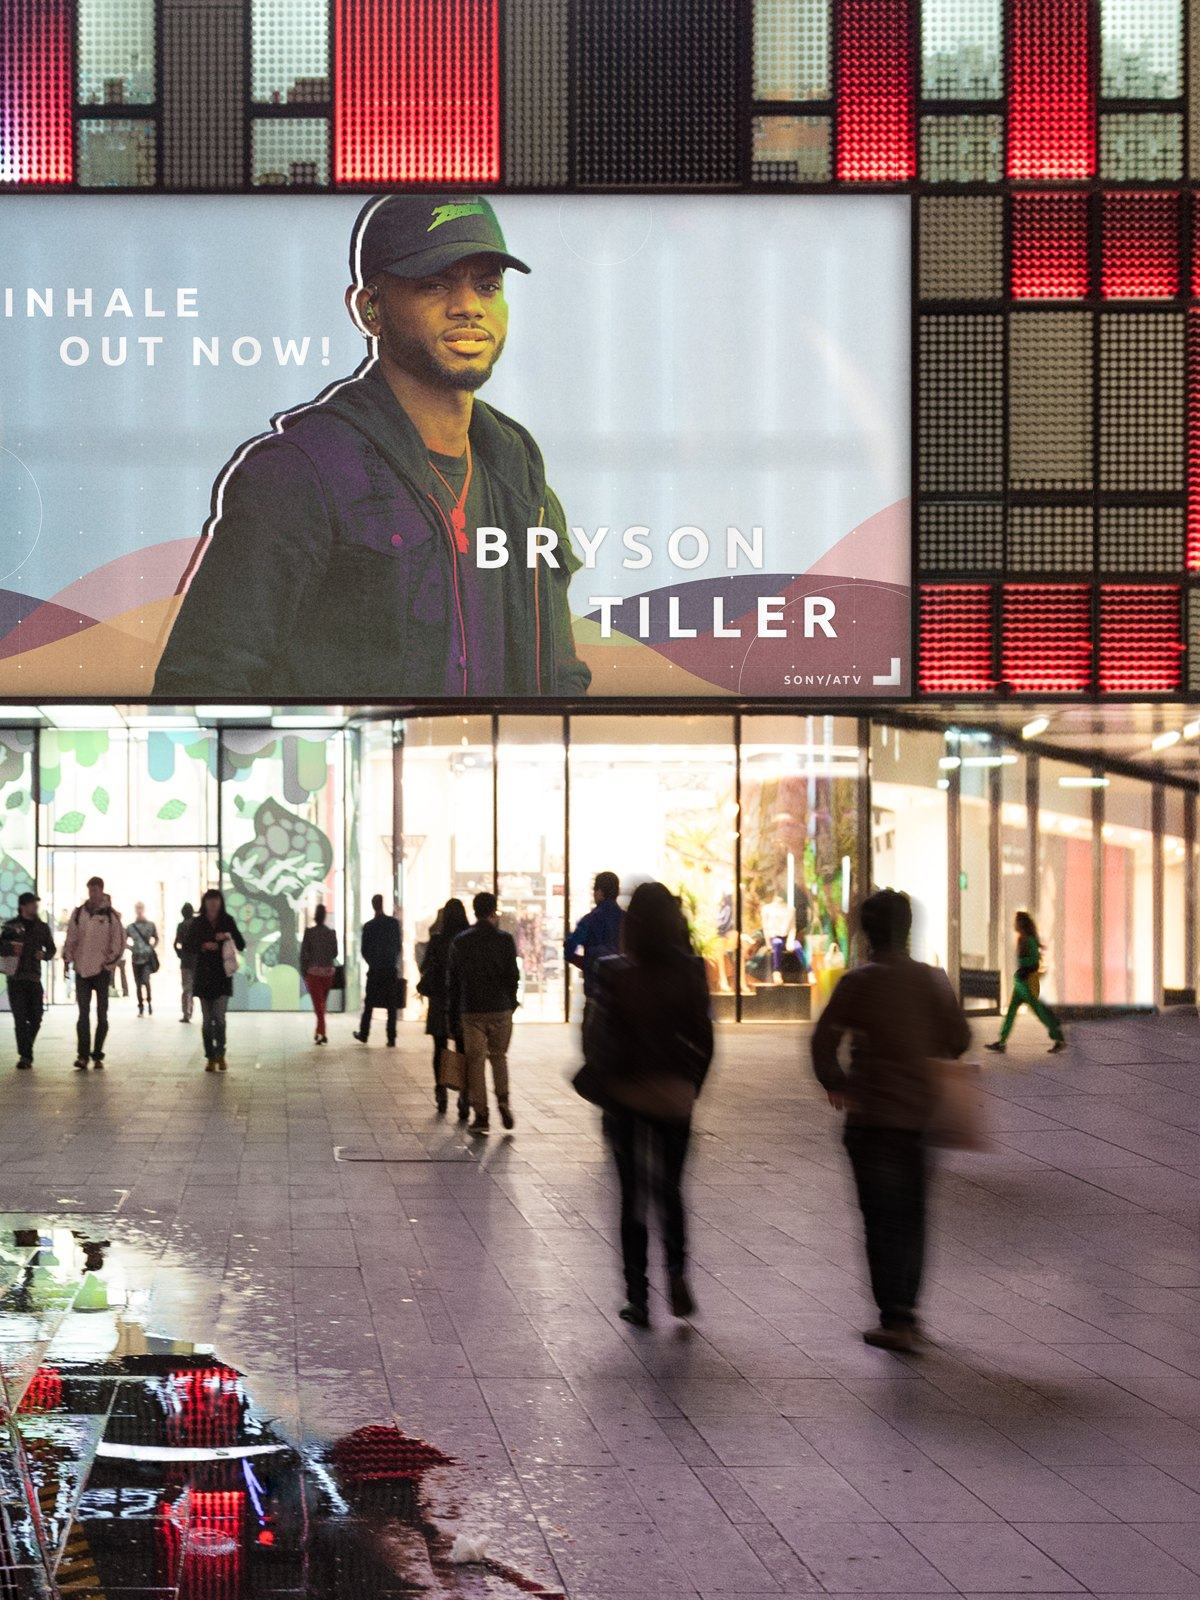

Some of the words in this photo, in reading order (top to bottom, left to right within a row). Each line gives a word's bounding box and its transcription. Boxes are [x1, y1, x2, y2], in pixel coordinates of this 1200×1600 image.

[5, 288, 199, 317] INHALE
[59, 336, 163, 366] OUT
[193, 336, 331, 366] NOW!
[475, 526, 765, 569] BRYSON
[589, 596, 838, 638] TILLER
[784, 674, 862, 686] SONY/ATV
